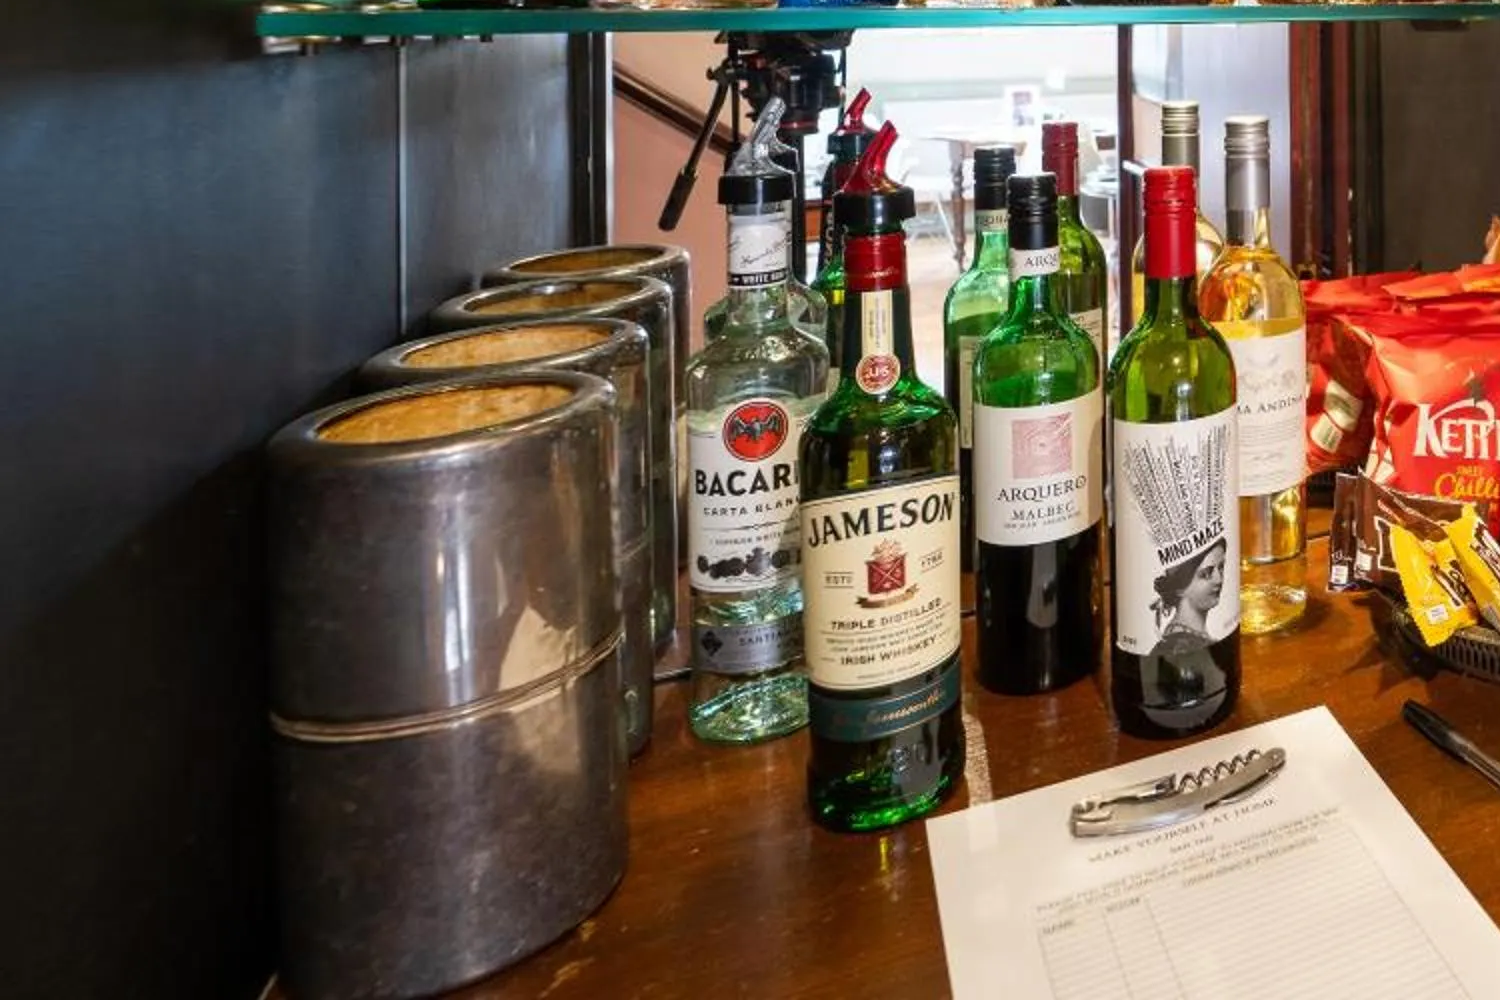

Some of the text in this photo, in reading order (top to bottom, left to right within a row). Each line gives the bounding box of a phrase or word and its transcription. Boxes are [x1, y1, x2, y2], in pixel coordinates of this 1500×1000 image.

[694, 461, 799, 497] BACAR
[997, 474, 1087, 502] ARQUERO
[1434, 472, 1500, 499] Chilli
[703, 506, 748, 517] CARTA
[808, 491, 954, 548] JAMESON
[1011, 499, 1074, 521] MALBEC
[1157, 515, 1224, 566] MIND MAZE
[831, 597, 942, 631] TRIPLE DISTILLED
[840, 654, 876, 666] IRISH
[880, 634, 937, 661] WHISKEY
